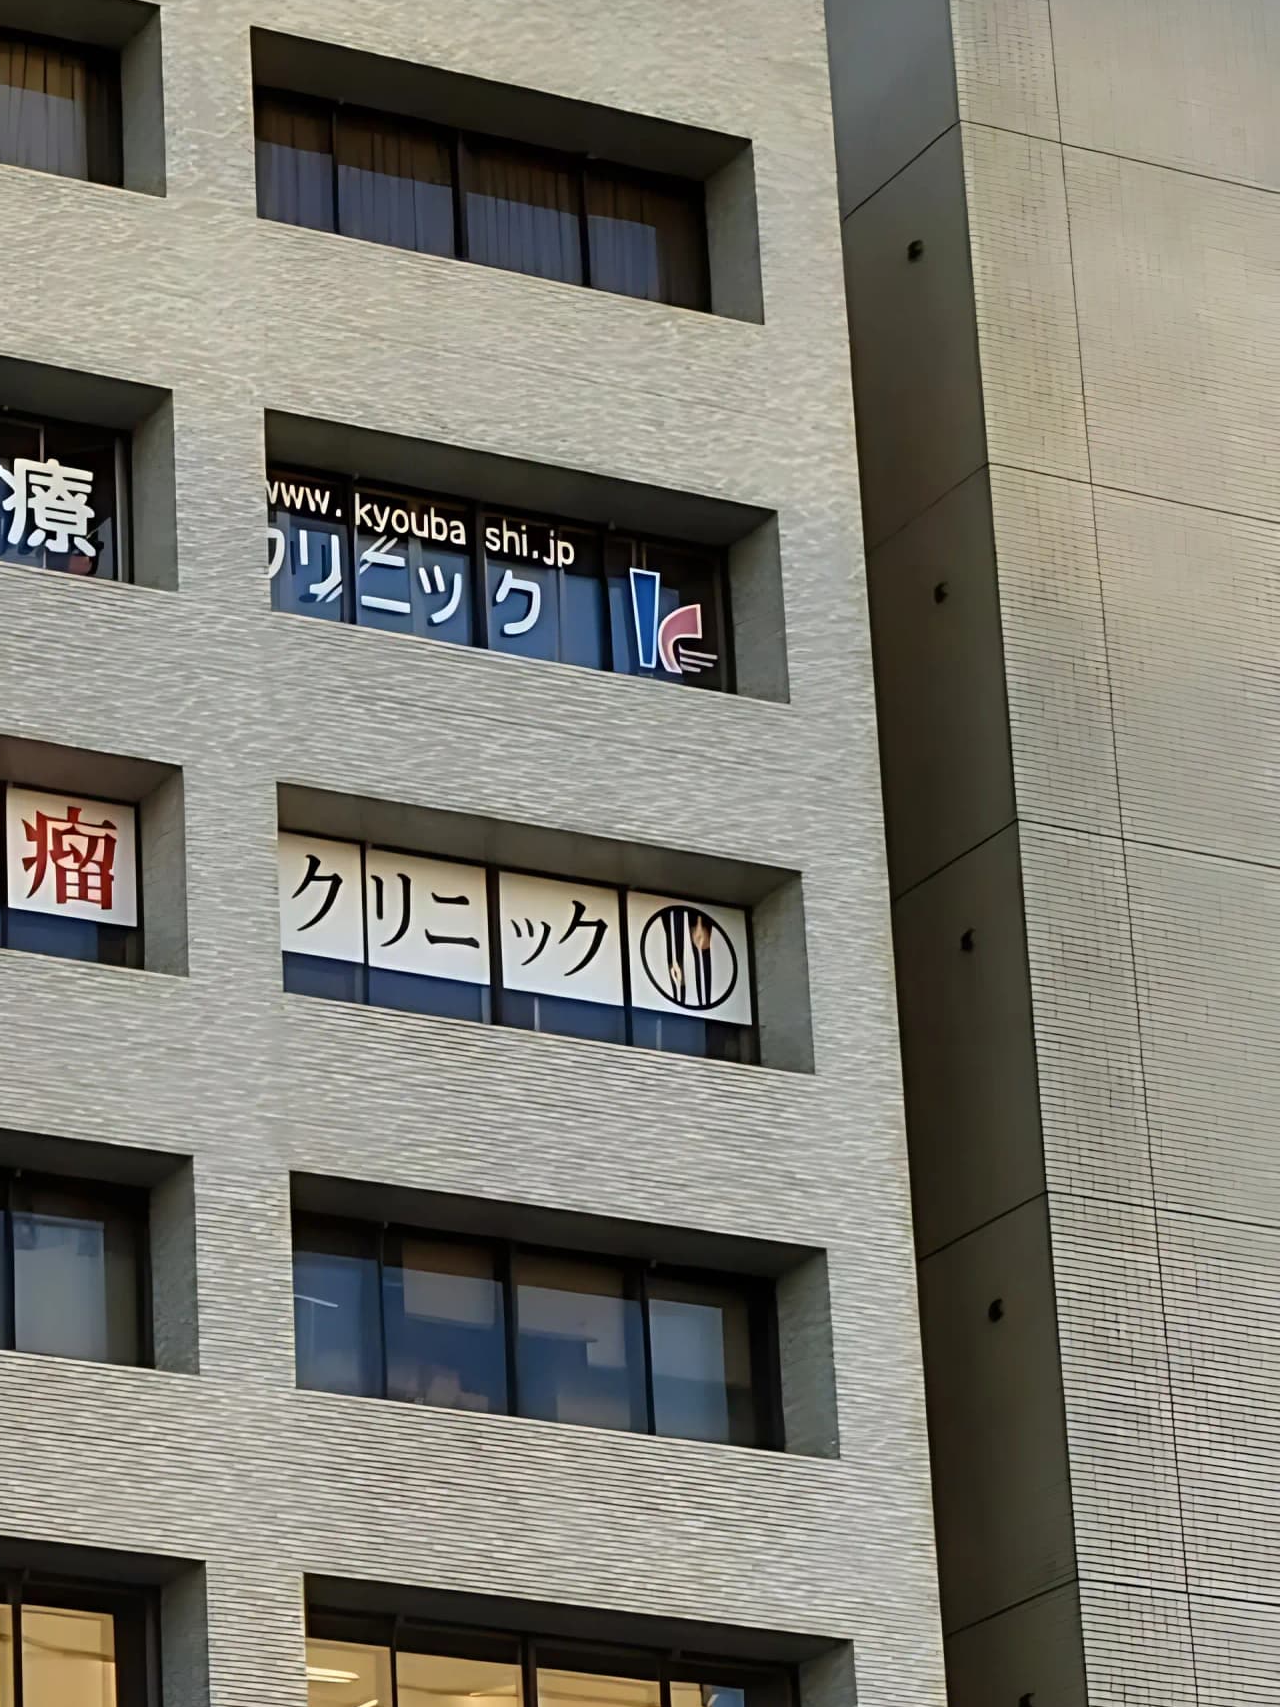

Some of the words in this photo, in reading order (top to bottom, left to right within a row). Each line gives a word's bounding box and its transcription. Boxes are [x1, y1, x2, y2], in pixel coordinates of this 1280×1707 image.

[292, 854, 608, 976] クリニック
